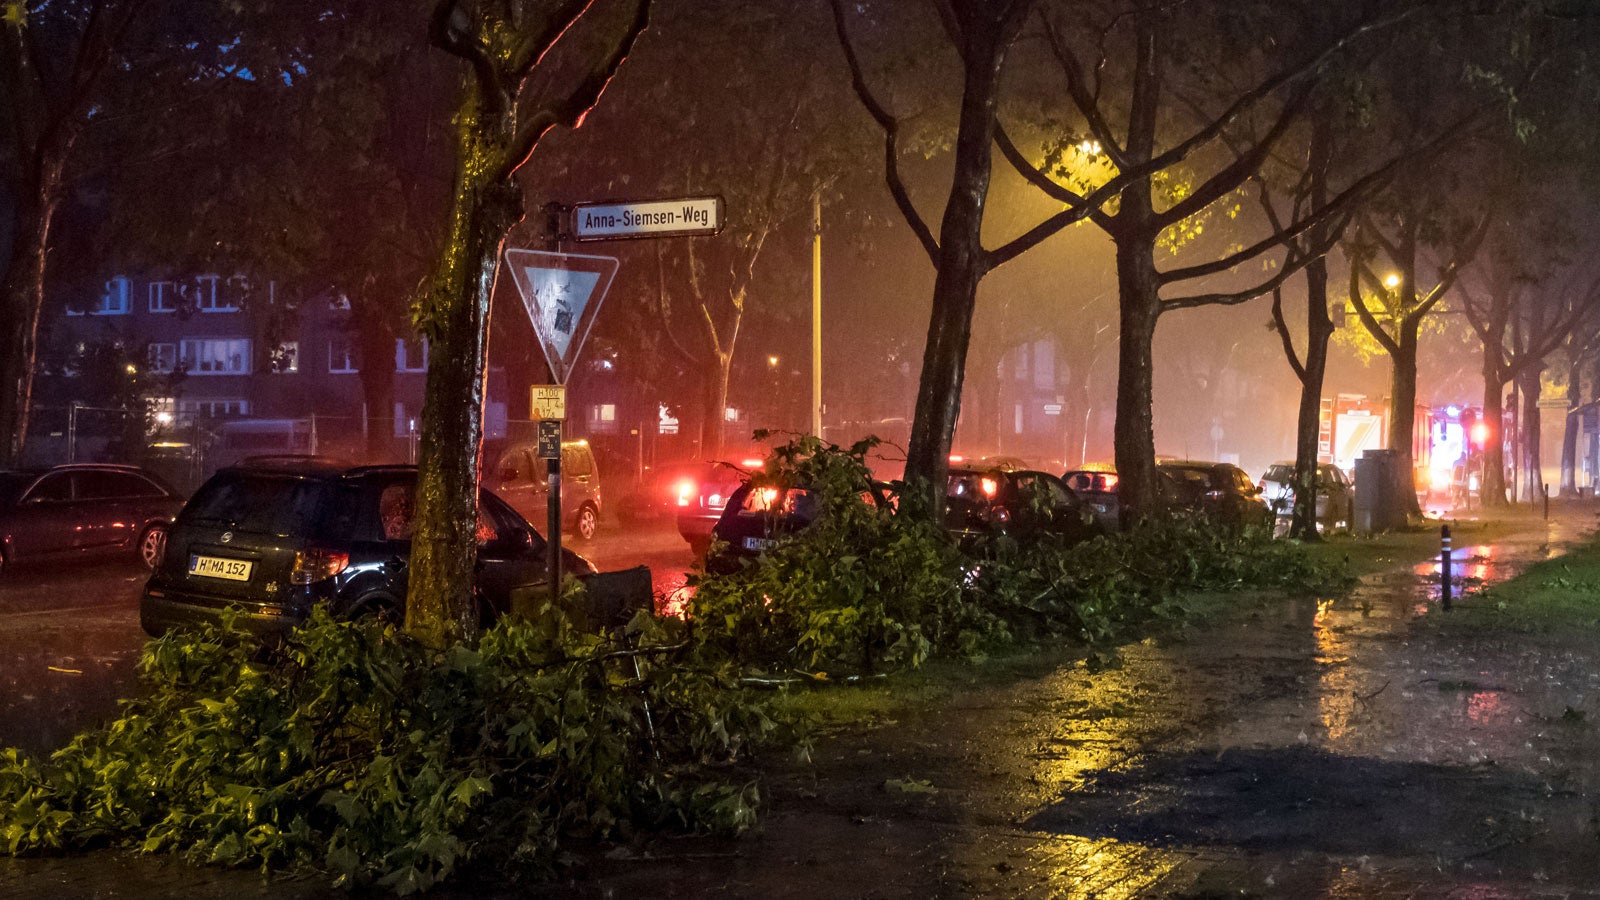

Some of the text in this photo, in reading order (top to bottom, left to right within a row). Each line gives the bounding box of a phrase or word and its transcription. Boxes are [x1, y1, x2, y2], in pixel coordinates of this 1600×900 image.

[585, 206, 708, 228] Anna-Siemsen-Weg
[199, 559, 207, 571] H
[211, 560, 225, 574] MA
[225, 562, 246, 576] 152
